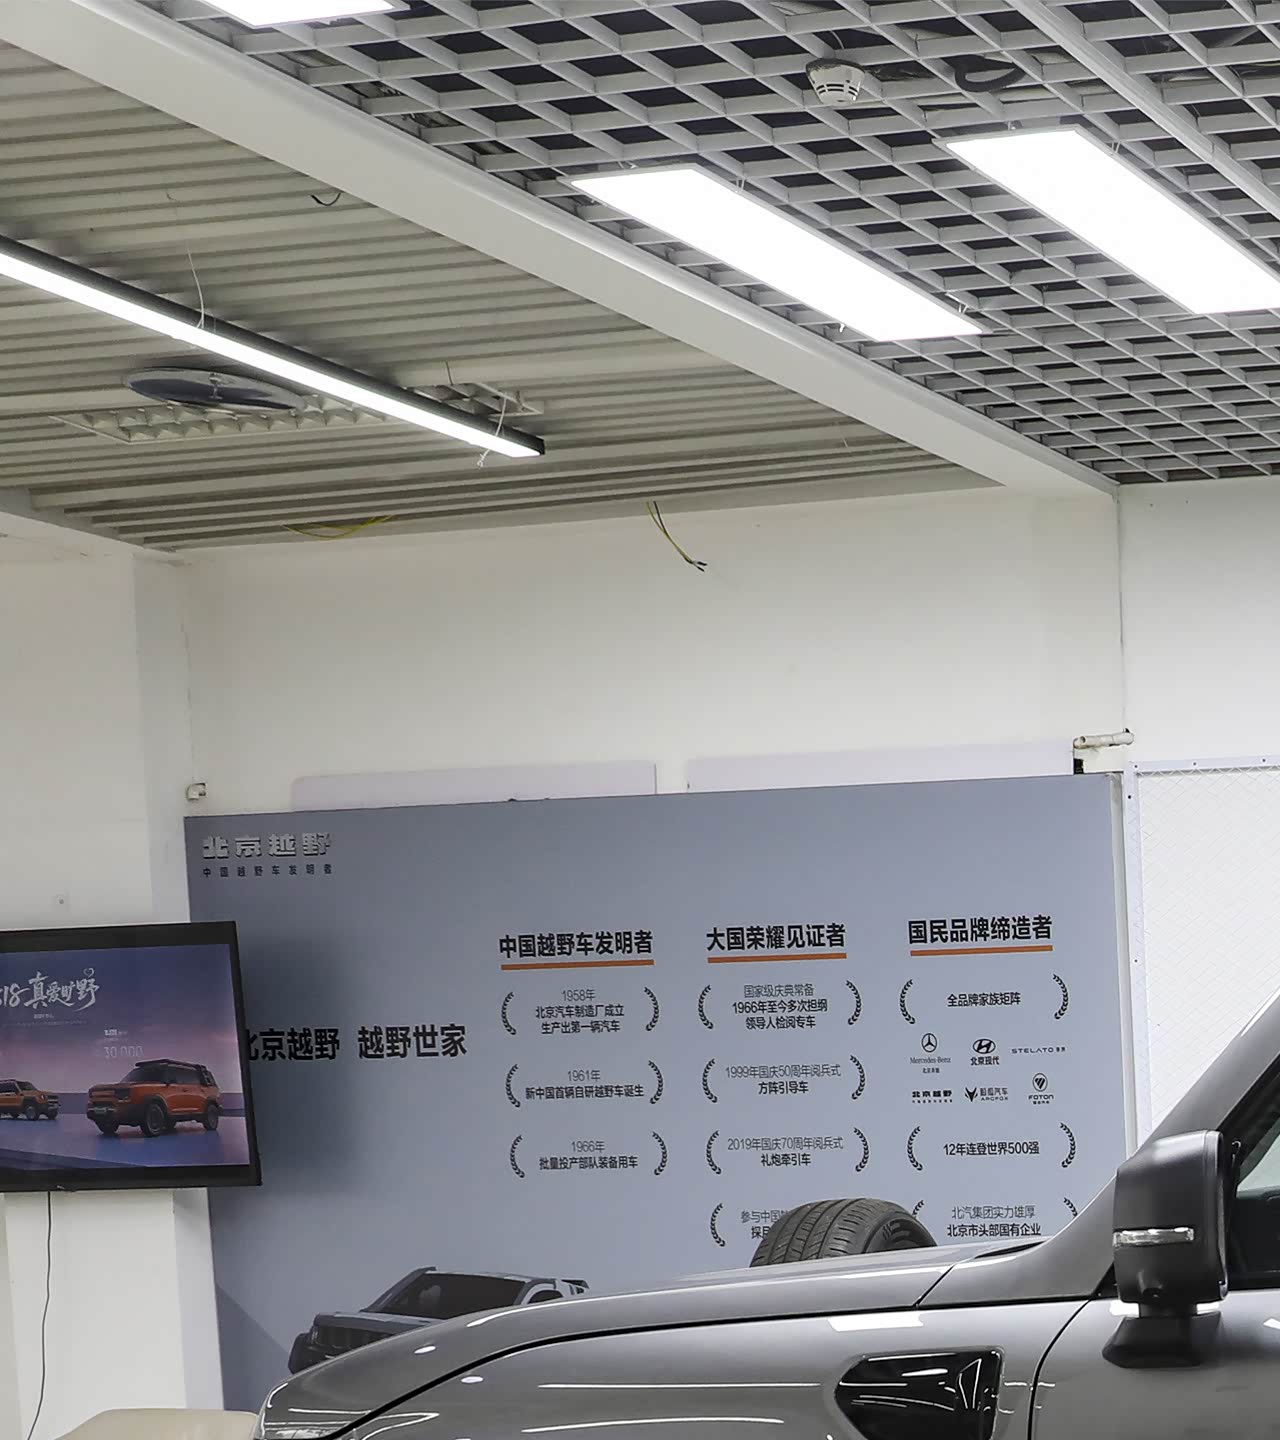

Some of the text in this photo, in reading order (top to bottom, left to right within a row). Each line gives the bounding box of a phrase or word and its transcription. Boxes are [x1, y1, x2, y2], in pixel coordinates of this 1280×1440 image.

[203, 833, 332, 859] 北京越野
[908, 915, 1053, 944] 国民品牌缔造者
[706, 923, 846, 951] 大国荣耀见证者
[499, 930, 653, 959] 中国越野车发明者
[0, 971, 100, 1012] 18真爱旷野
[562, 989, 596, 1001] 1958年
[732, 999, 828, 1014] 1966年至今多次担纲
[947, 992, 1021, 1008] 全品牌家族矩阵
[536, 1004, 625, 1019] 北京汽车制造厂成立
[541, 1020, 621, 1034] 生产出第一辆汽车
[746, 1016, 816, 1030] 领导人检阅专车
[358, 1024, 468, 1060] 越野世家
[970, 1056, 1000, 1066] 北京现代
[568, 1070, 601, 1082] 1961年
[725, 1064, 841, 1078] 1999年国庆50周年阅兵式
[525, 1084, 645, 1100] 新中国首辆自研越野车诞生
[758, 1081, 809, 1095] 方阵引导车
[571, 1141, 605, 1153] 1966年
[727, 1137, 844, 1151] 2019年国庆70周年阅兵式
[943, 1141, 1040, 1156] 12年连登世界500强
[539, 1155, 639, 1170] 批量投产部队装备用车
[761, 1153, 811, 1166] 礼炮牵引车
[741, 1210, 785, 1223] 参与中国
[952, 1205, 1036, 1219] 北汽集团实力雄厚
[947, 1223, 1041, 1237] 北京市头部国有企业
